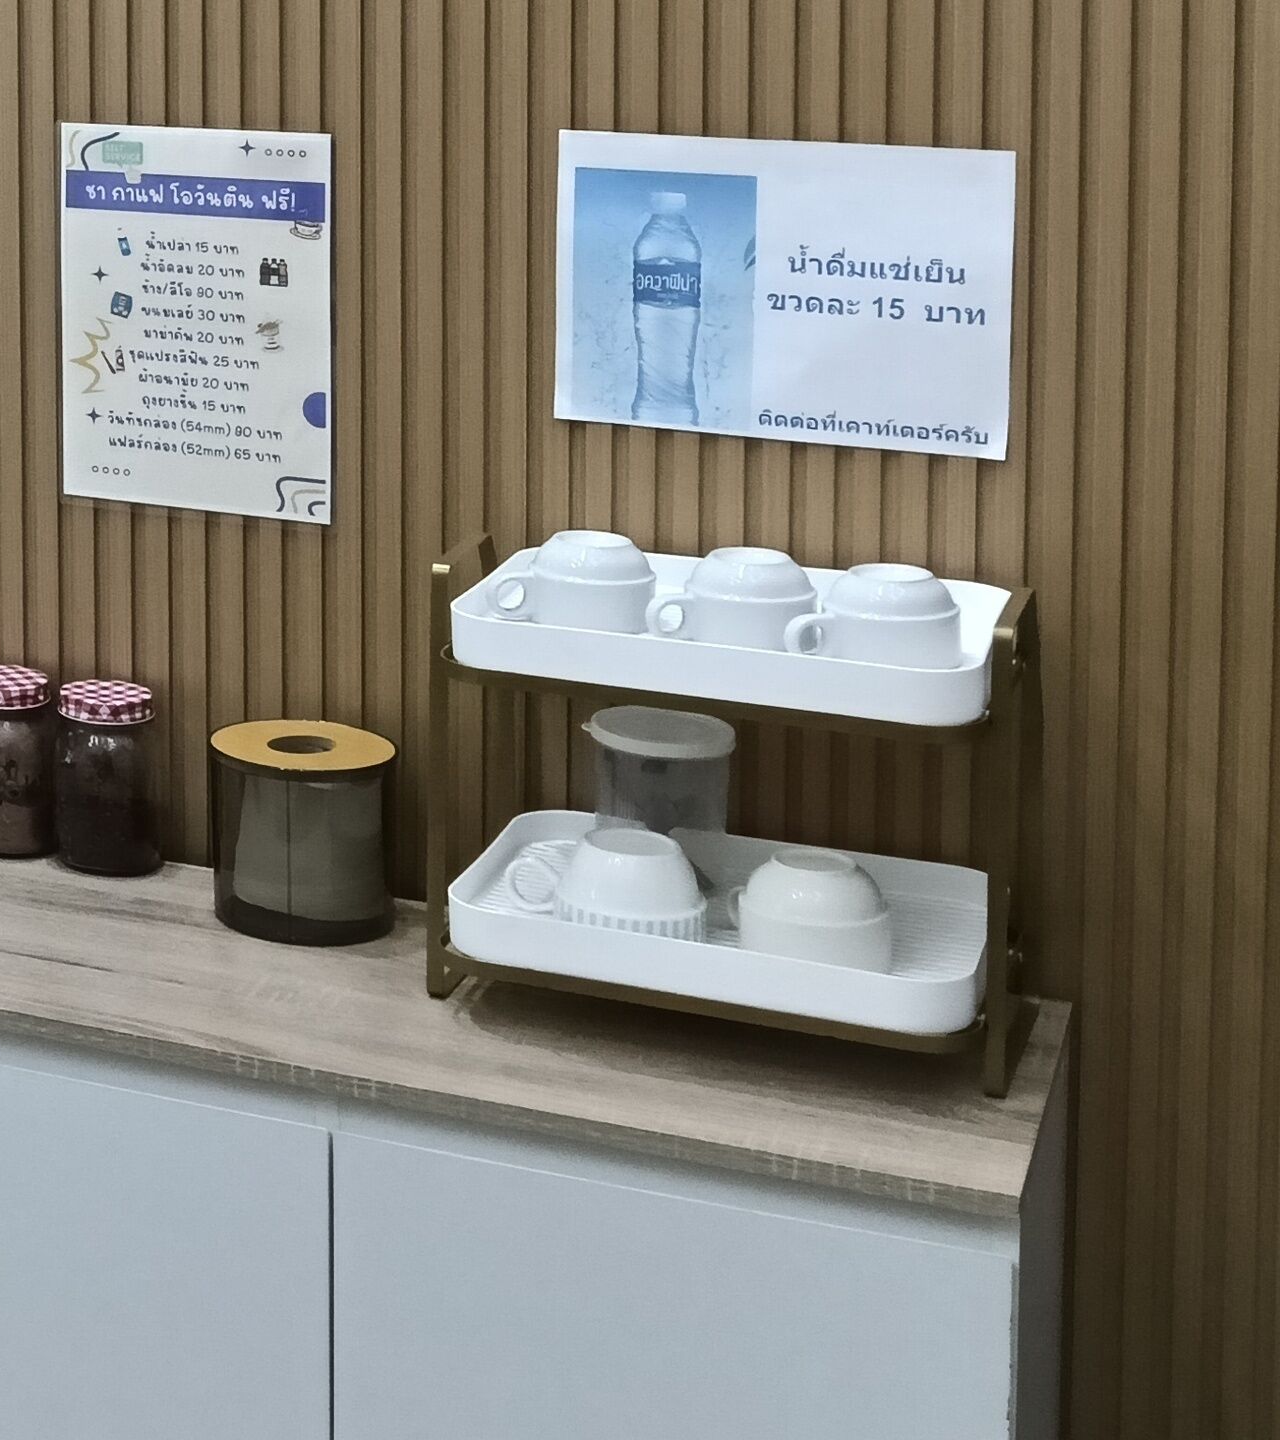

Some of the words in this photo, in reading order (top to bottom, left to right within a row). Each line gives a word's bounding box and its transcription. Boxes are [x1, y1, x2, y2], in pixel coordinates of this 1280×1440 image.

[85, 184, 106, 200] ชา
[112, 184, 164, 205] กาแฟ
[170, 182, 254, 210] โอวันติน
[261, 187, 297, 213] ฟรี!
[144, 231, 192, 253] น้ำเปล่า
[195, 242, 209, 253] 15
[213, 243, 240, 256] บาท
[140, 254, 194, 275] น้ำอัดลม
[198, 264, 215, 277] 20
[218, 266, 246, 279] บาท
[787, 244, 966, 287] น้ำดื่มแช่เย็น
[141, 279, 193, 298] ช้าง/ลีโอ
[218, 290, 245, 301] บาท
[141, 304, 194, 321] ขนมเลย์
[197, 309, 215, 321] 30
[219, 312, 246, 324] บาท
[766, 290, 861, 317] ขวดละ
[872, 296, 905, 321] 15
[924, 301, 987, 327] บาท
[197, 332, 215, 344] 20
[218, 335, 245, 346] บาท
[212, 355, 230, 367] 25
[233, 358, 260, 370] บาท
[138, 368, 199, 388] ผ้าอนามัย
[202, 377, 220, 390] 20
[223, 380, 250, 392] บาท
[201, 400, 216, 411] 15
[220, 403, 246, 414] บาท
[180, 418, 231, 437] (54mm)
[256, 428, 283, 441] บาท
[180, 441, 231, 460] (52mm)
[234, 448, 251, 461] 65
[255, 452, 282, 464] บาท
